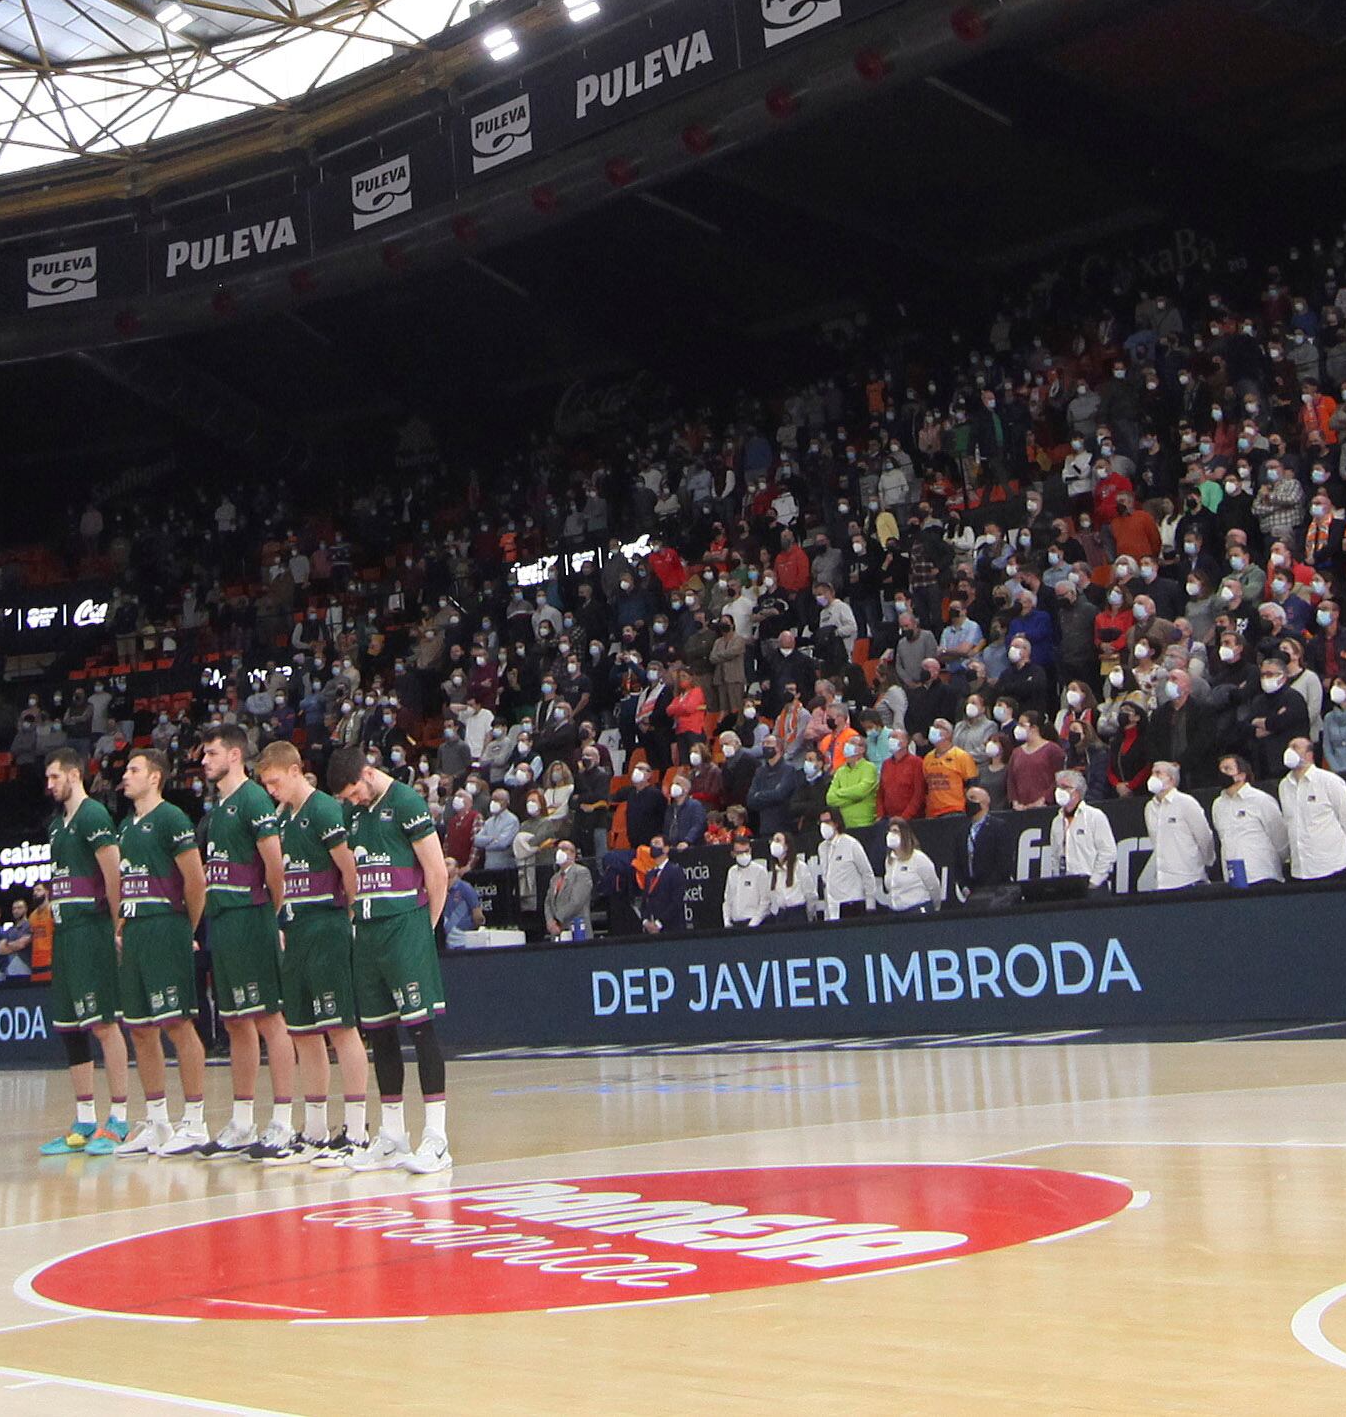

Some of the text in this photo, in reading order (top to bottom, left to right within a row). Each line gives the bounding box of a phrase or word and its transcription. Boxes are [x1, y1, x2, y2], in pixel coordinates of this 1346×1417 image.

[576, 29, 713, 119] PULEVA
[475, 104, 527, 139] PULEVA
[355, 165, 407, 195] PULEVA
[32, 255, 93, 277] PULEVA
[166, 216, 297, 278] PULEVA
[592, 938, 1142, 1016] DEP JAVIER IMBRODA
[410, 1182, 969, 1270] PAMESA
